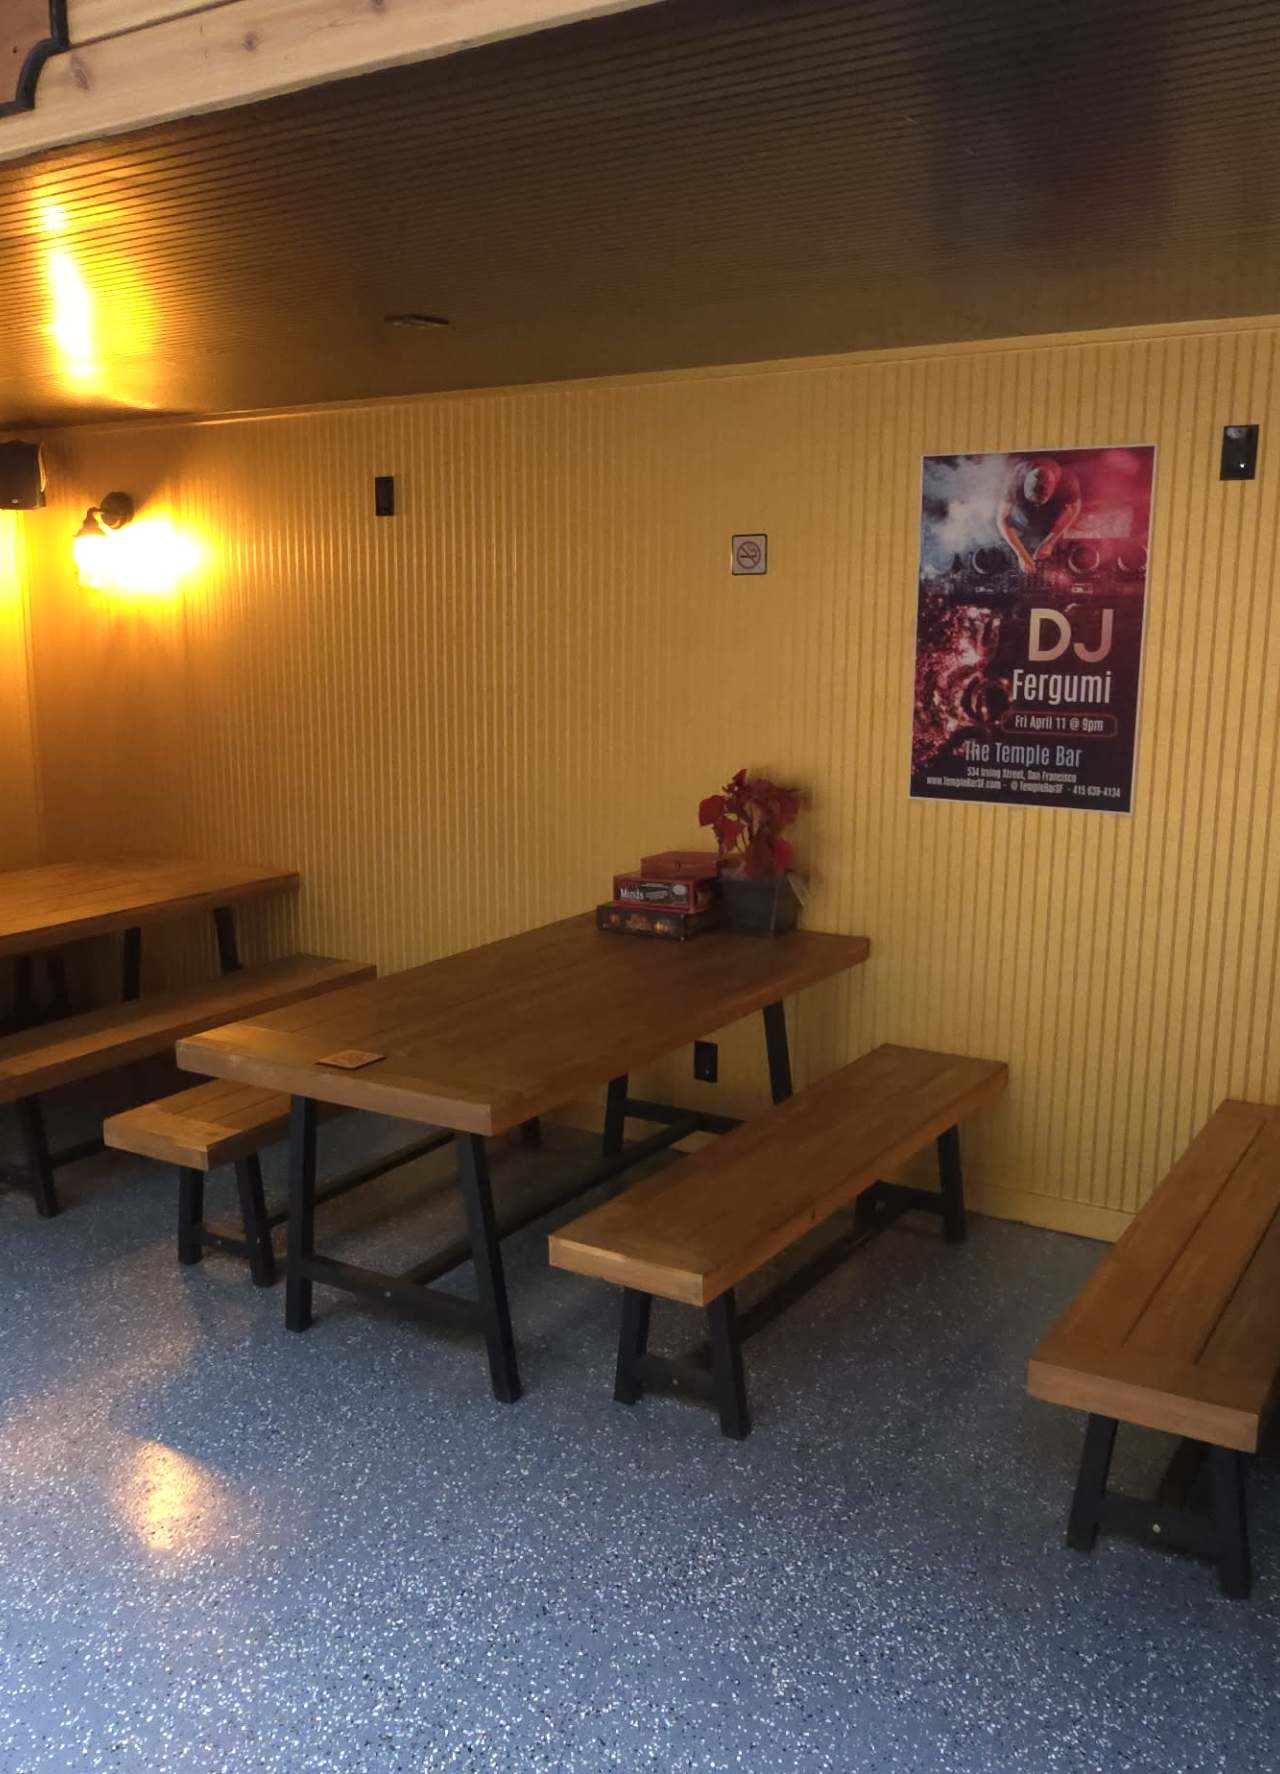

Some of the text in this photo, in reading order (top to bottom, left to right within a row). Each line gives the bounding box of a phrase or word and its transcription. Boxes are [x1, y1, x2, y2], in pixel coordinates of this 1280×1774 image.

[1028, 608, 1115, 663] DJ
[1012, 669, 1112, 705] Fergumi
[1015, 715, 1105, 733] Fri April 11 @ 9pm
[965, 738, 1083, 768] The Temple Bar
[1042, 771, 1077, 783] Francisco
